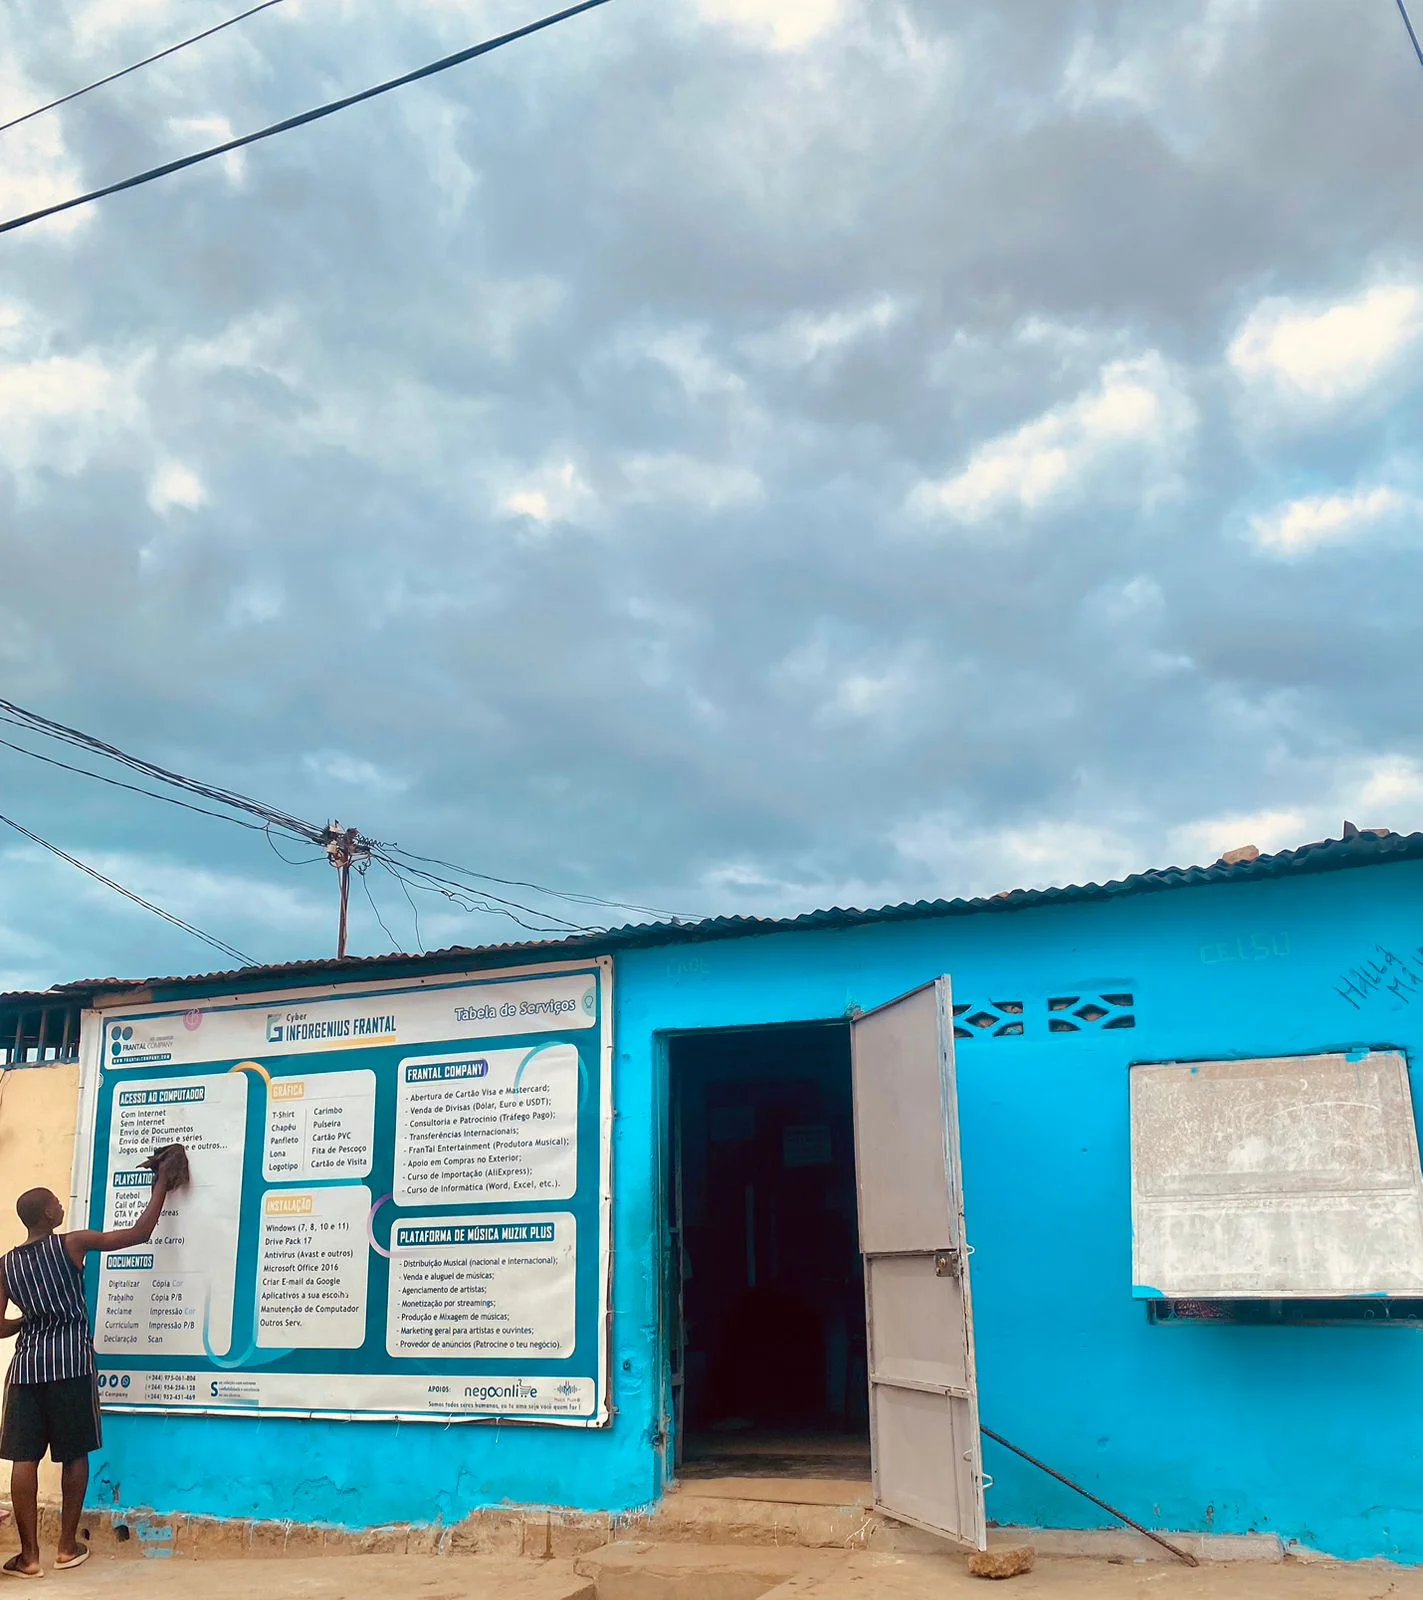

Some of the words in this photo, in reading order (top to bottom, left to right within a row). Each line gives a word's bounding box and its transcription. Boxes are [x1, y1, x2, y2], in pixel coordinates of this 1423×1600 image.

[455, 1006, 496, 1021] Tabela
[500, 1003, 515, 1016] de
[519, 999, 575, 1015] Serviços
[286, 1013, 307, 1022] Cyber
[286, 1020, 349, 1041] INFORGENIUS
[354, 1016, 396, 1034] FRANTAL
[408, 1068, 442, 1081] FRANTAL
[445, 1064, 482, 1078] COMPANY
[120, 1094, 146, 1104] ACESSO
[148, 1092, 158, 1102] AO
[160, 1088, 204, 1101] COMPUTADOR
[411, 1093, 442, 1102] Abertura
[456, 1090, 479, 1099] Cartão
[506, 1085, 550, 1094] Mastercard;
[314, 1108, 342, 1116] Carimbo
[152, 1126, 193, 1134] Documentos
[271, 1137, 298, 1145] Panfleto
[313, 1134, 335, 1142] Cartão
[338, 1132, 351, 1140] PVC
[339, 1145, 367, 1153] Pescoço
[269, 1163, 298, 1172] Logotipo
[311, 1160, 334, 1168] Cartão
[348, 1158, 367, 1166] Visita
[408, 1160, 428, 1168] Apoio
[444, 1158, 474, 1166] Compras
[115, 1173, 155, 1185] PLAYSTATIO
[268, 1198, 311, 1212] INSTALAÇÃO
[113, 1219, 133, 1227] Mortal
[400, 1229, 451, 1243] PLATAFORMA
[455, 1229, 464, 1240] DE
[468, 1226, 499, 1240] MÚSICA
[502, 1227, 527, 1239] MUZIK
[531, 1226, 552, 1238] PLUS
[108, 1256, 152, 1267] DOCUMENTOS
[404, 1259, 442, 1268] Distribuição
[470, 1258, 500, 1267] (nacional
[508, 1257, 558, 1266] internacional);
[431, 1273, 454, 1281] aluguel
[466, 1272, 494, 1280] músicas;
[316, 1278, 340, 1286] Google
[402, 1286, 448, 1295] Agenciamento
[460, 1286, 487, 1294] artistas;
[261, 1306, 302, 1314] Manutenção
[316, 1306, 359, 1314] Computador
[402, 1314, 432, 1322] Produção
[440, 1313, 468, 1322] Mixagem
[481, 1312, 510, 1321] músicas;
[401, 1327, 433, 1336] Marketing
[435, 1327, 451, 1335] geral
[502, 1326, 534, 1335] ouvintes;
